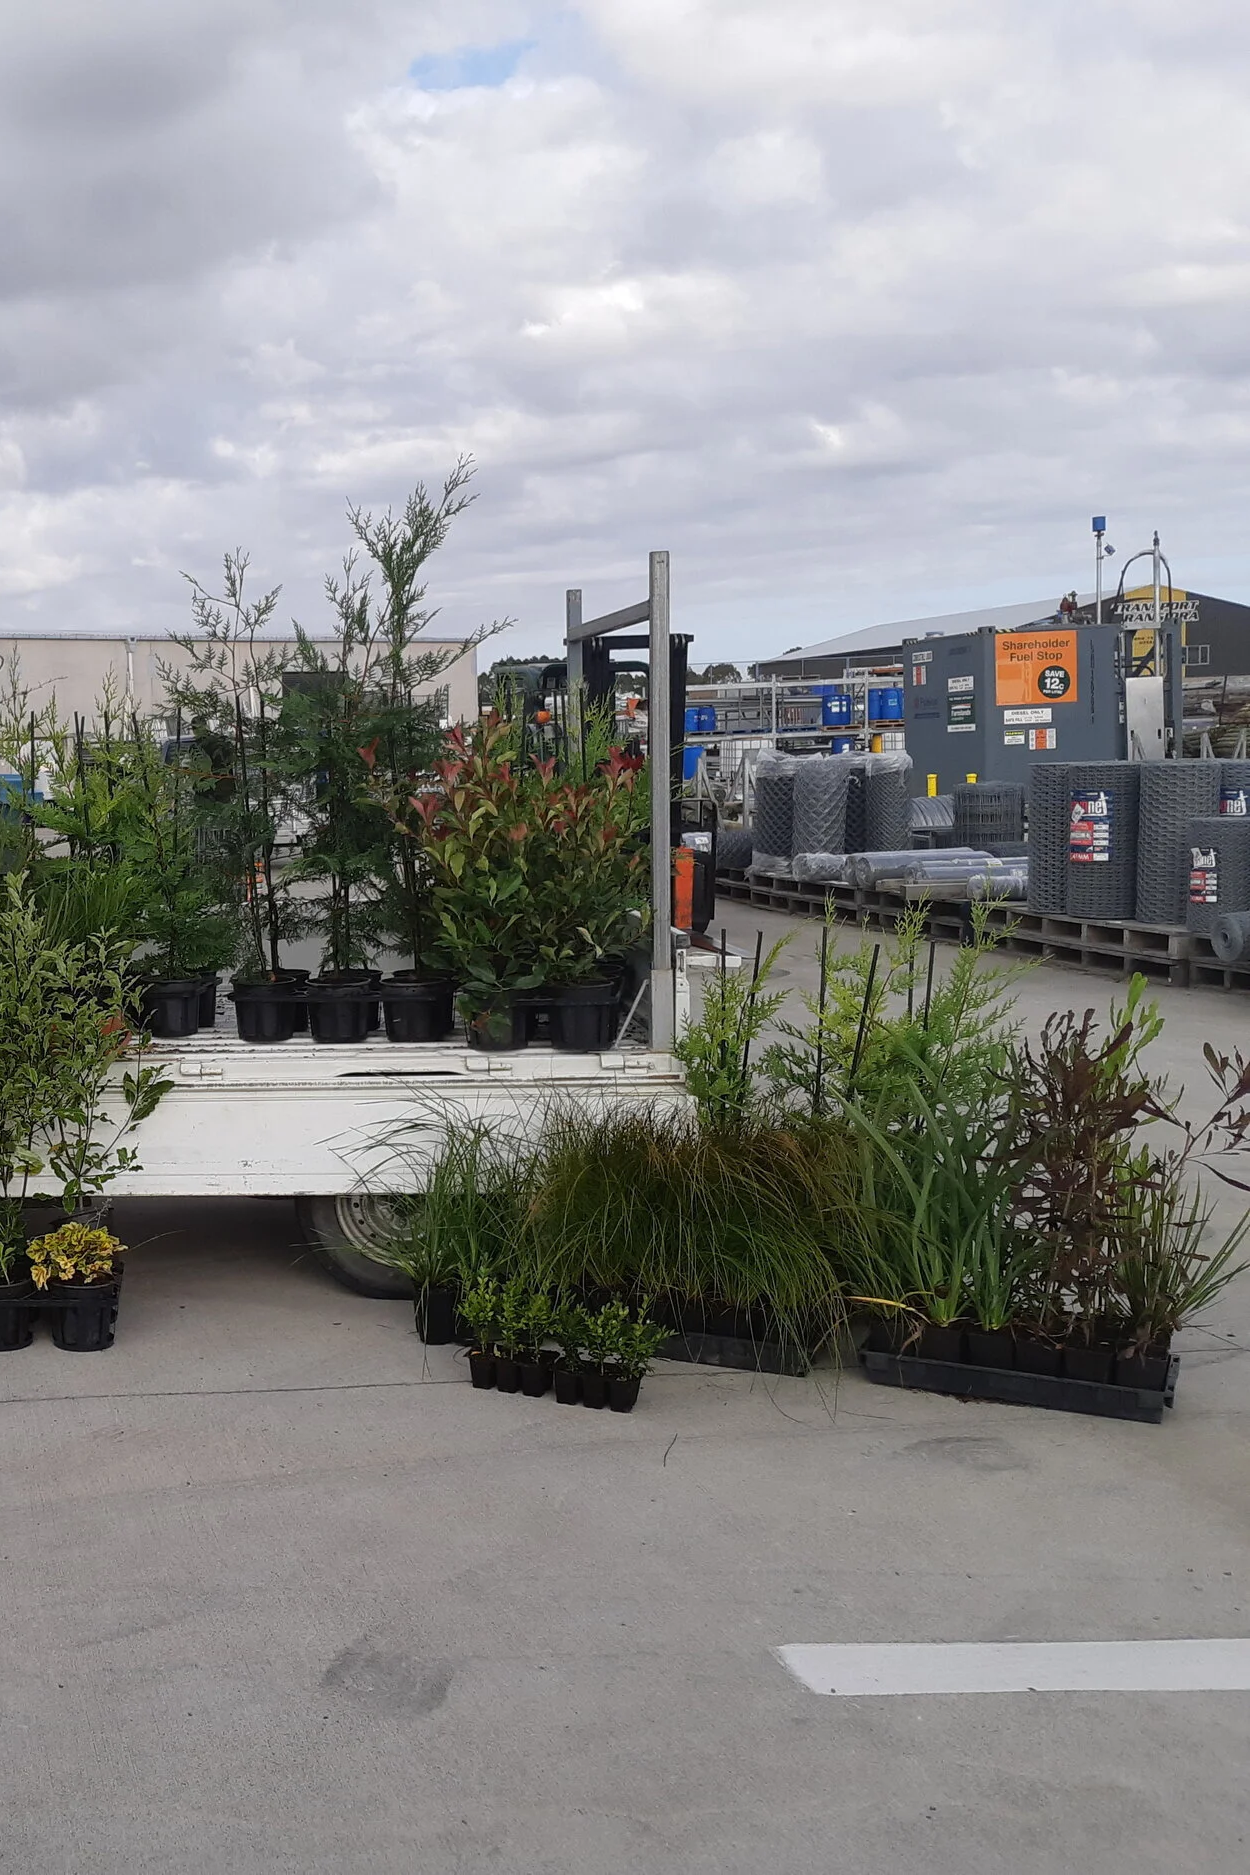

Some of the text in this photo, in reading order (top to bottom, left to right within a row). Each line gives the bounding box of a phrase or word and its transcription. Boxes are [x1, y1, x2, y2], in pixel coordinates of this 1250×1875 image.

[1002, 639, 1070, 650] Shareholder
[1010, 651, 1063, 662] Fuel Stop
[1044, 670, 1065, 678] SAVE
